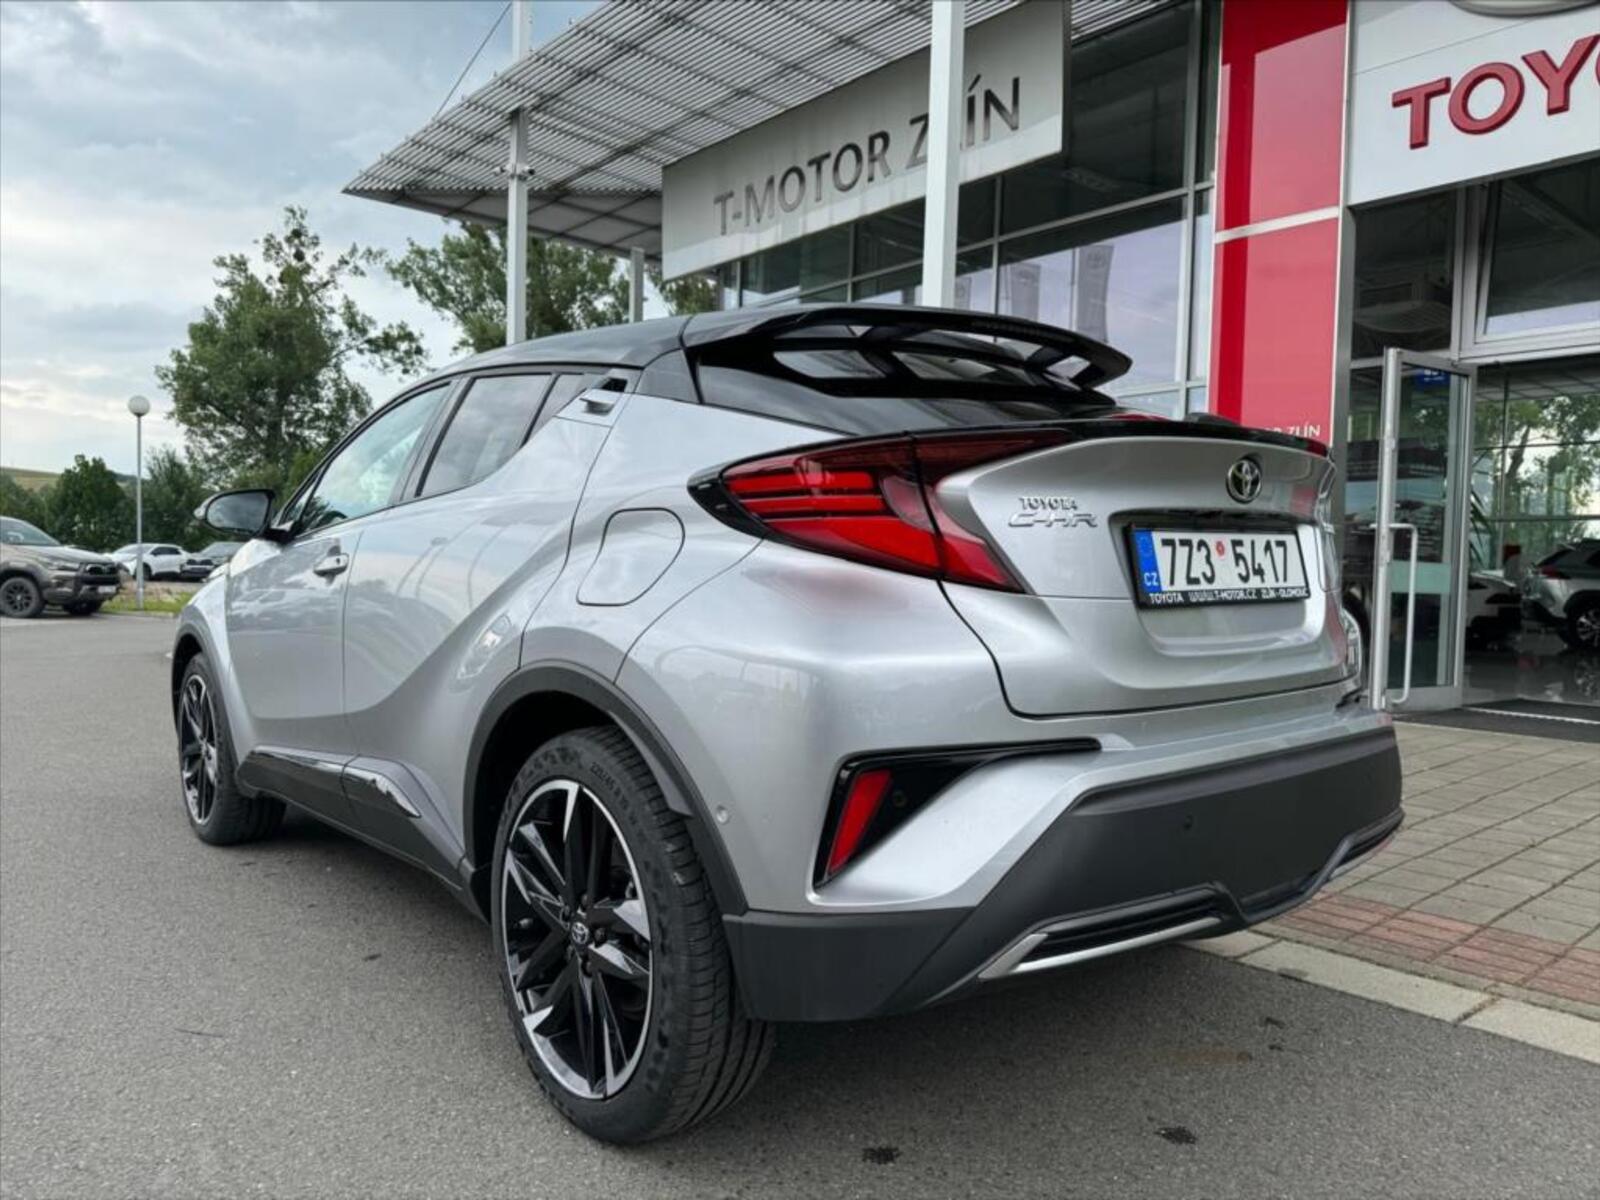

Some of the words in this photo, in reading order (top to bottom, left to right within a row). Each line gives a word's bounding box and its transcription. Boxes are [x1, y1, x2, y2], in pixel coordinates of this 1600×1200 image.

[1392, 34, 1600, 150] TOY
[713, 130, 892, 236] T-MOTOR
[905, 74, 1019, 170] ZÍN
[1018, 496, 1078, 511] TOYOTA
[1008, 511, 1098, 528] C-HR
[1161, 538, 1216, 587] 7Z3
[1230, 538, 1288, 584] 5417
[1144, 572, 1159, 586] CZ
[1149, 592, 1184, 605] TOYOTA
